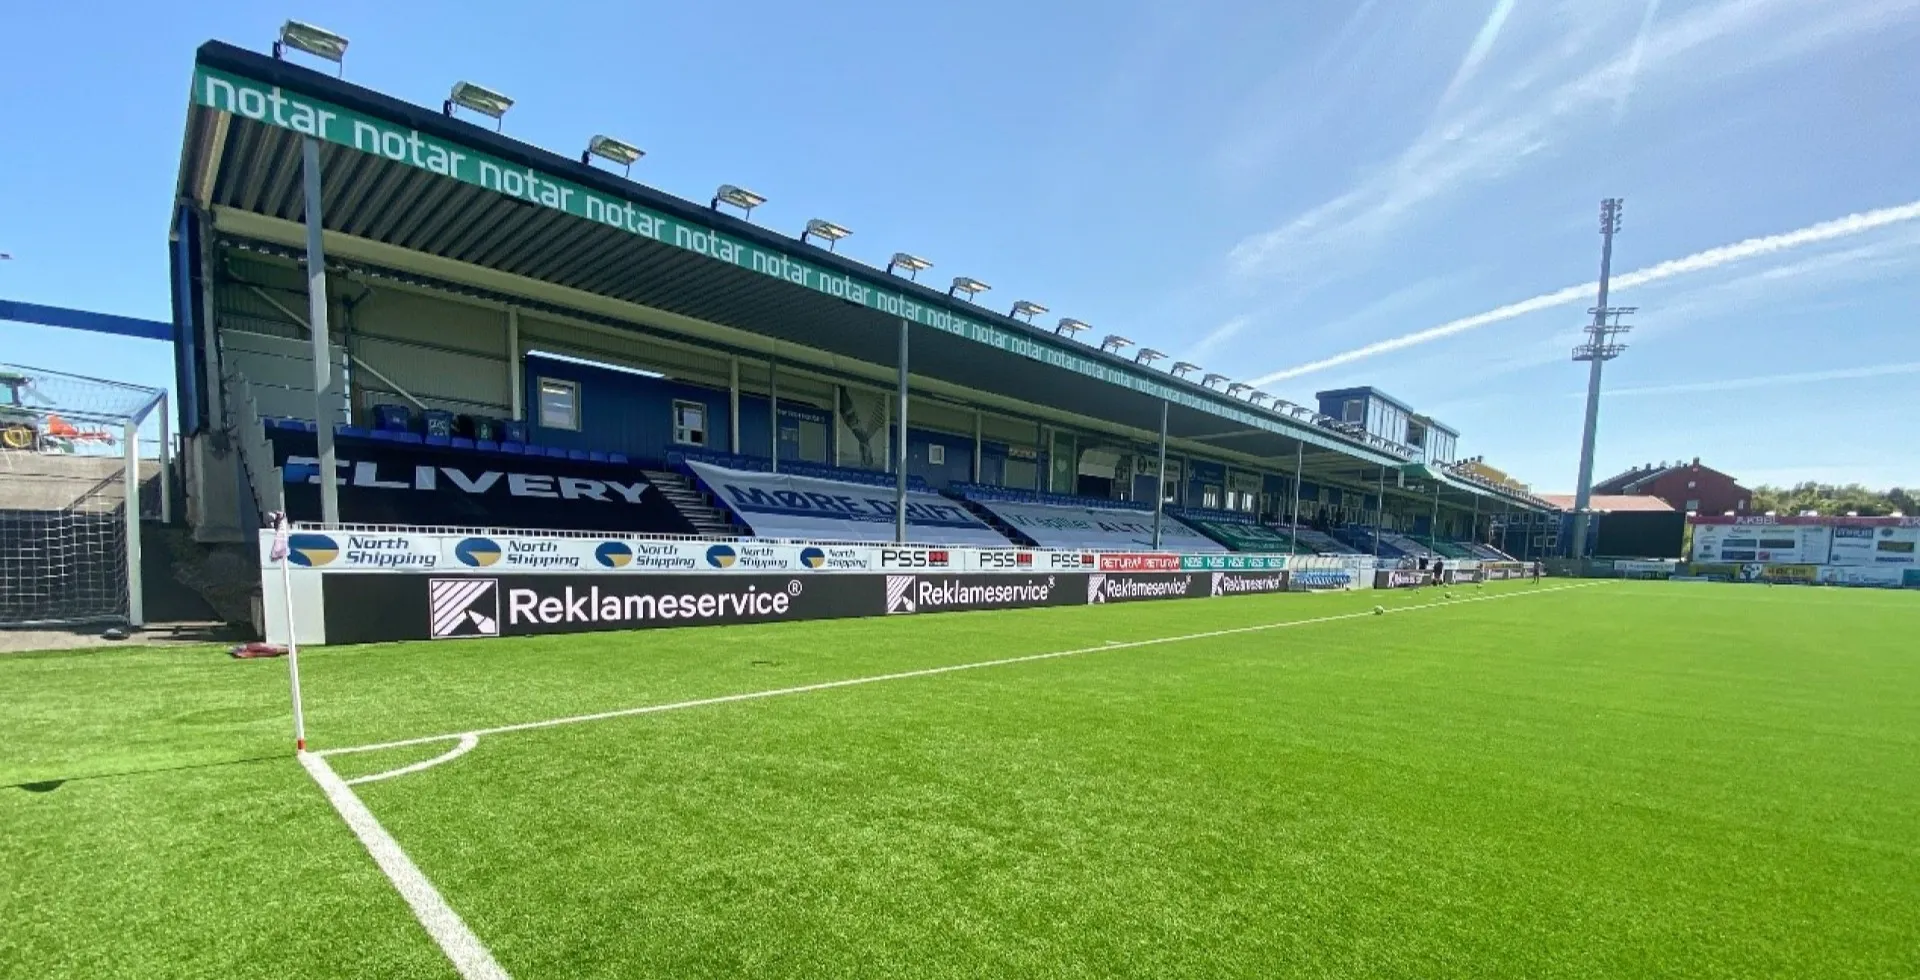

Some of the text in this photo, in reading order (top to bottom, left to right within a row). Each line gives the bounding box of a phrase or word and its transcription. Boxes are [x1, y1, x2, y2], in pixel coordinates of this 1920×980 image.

[206, 76, 336, 139] notar
[354, 120, 467, 179] notar
[479, 160, 574, 211] notar
[586, 195, 665, 240] notar
[676, 224, 743, 265] notar
[752, 249, 811, 285] notar
[820, 272, 870, 305] notar
[877, 292, 921, 321] notar
[927, 308, 968, 337] notar
[972, 323, 1006, 349] notar
[1012, 338, 1044, 360] notar
[724, 484, 866, 513] MØRE
[863, 498, 970, 521] DRIFT
[348, 536, 409, 550] North
[508, 540, 557, 553] North
[637, 544, 678, 556] North
[740, 547, 774, 557] North
[881, 549, 927, 567] PSS
[346, 551, 437, 568] Shipping
[507, 553, 580, 568] Shipping
[636, 555, 695, 569] Shipping
[980, 552, 1016, 568] PSS
[1051, 554, 1080, 568] PSS
